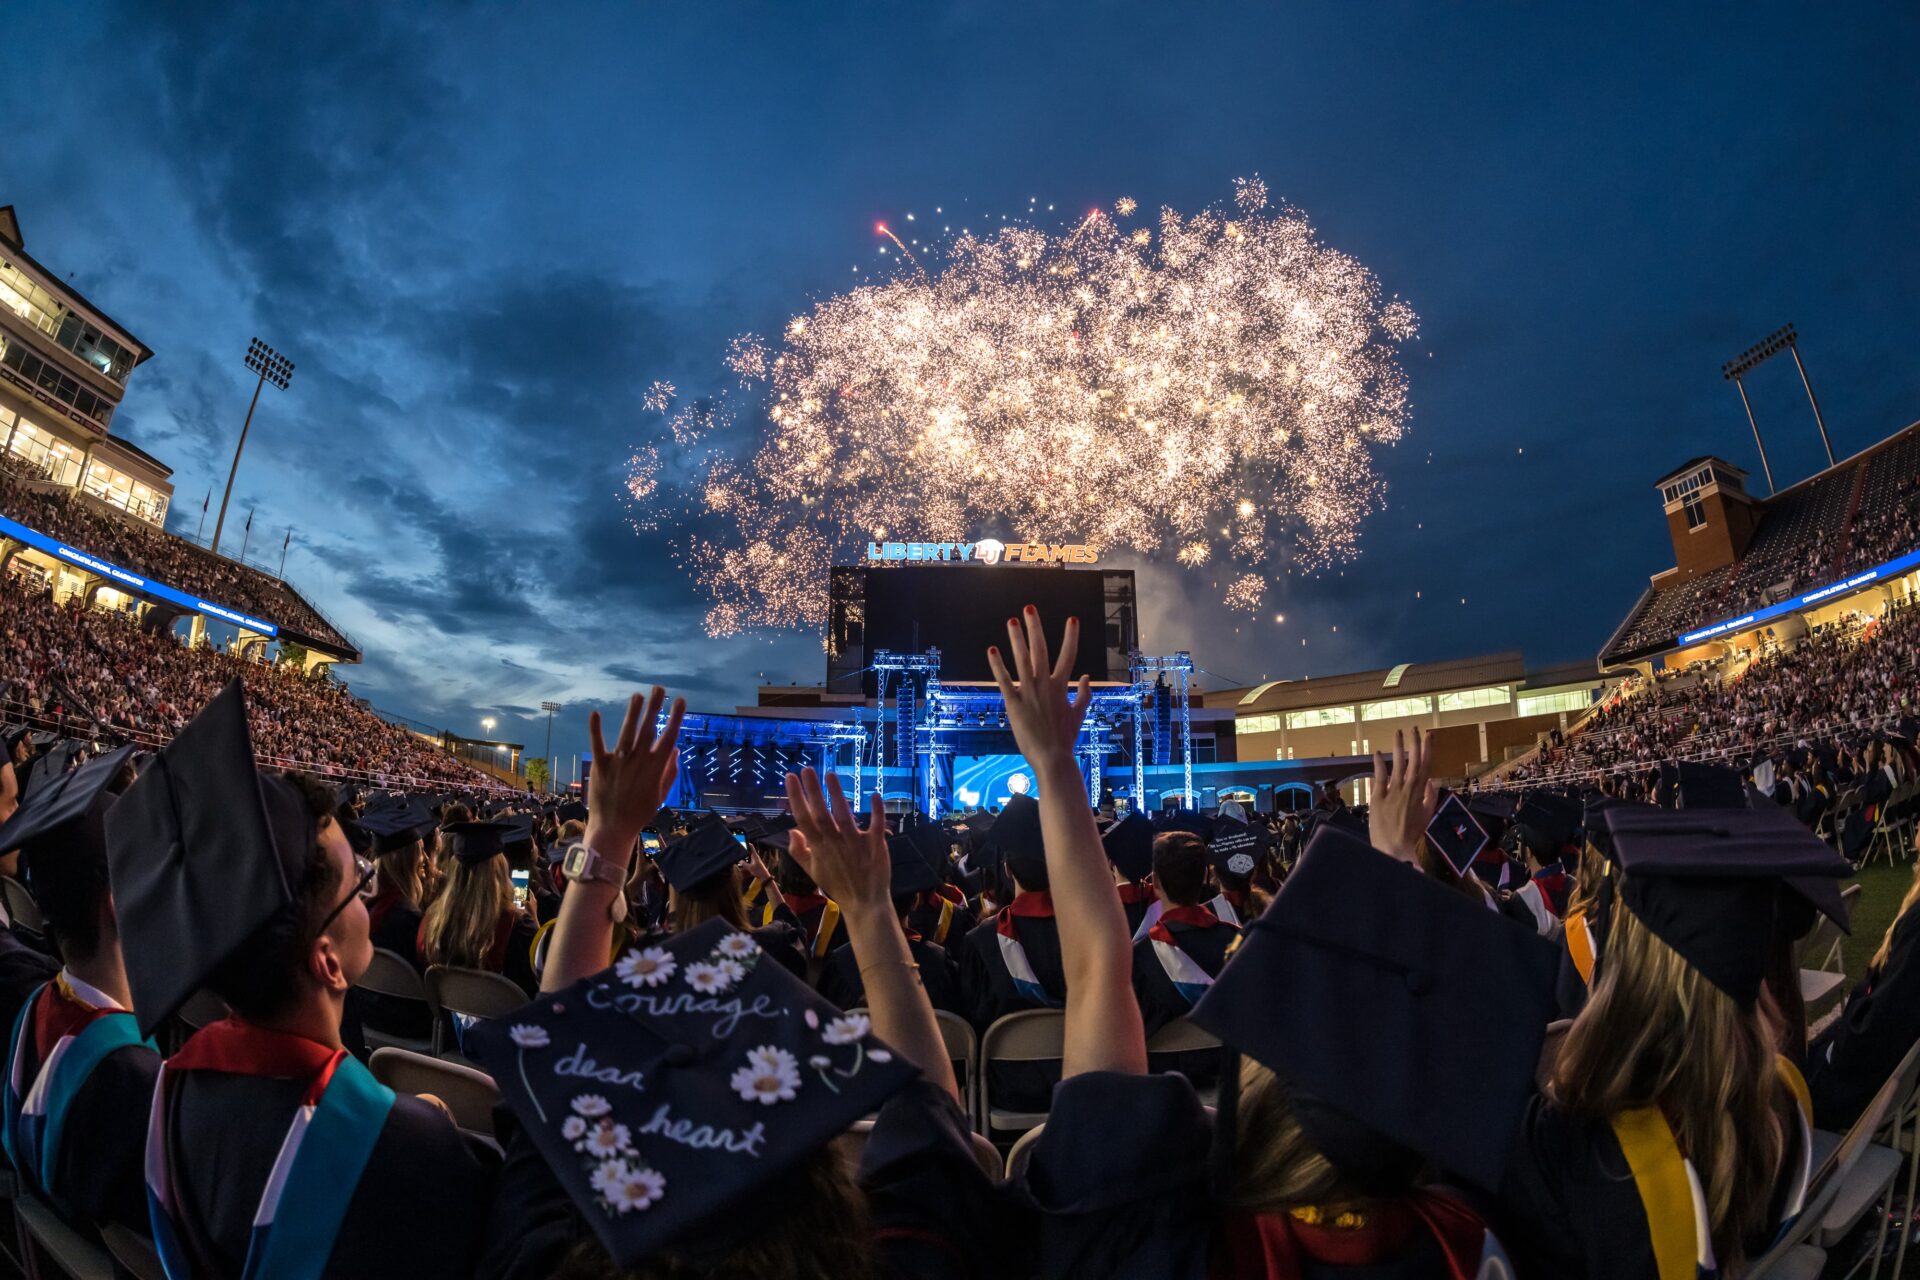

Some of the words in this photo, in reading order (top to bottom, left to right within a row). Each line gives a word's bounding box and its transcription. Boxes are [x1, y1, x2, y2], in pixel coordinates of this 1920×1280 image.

[867, 542, 976, 562] LIBERTY
[1003, 543, 1099, 564] FLAMES
[554, 1042, 645, 1091] dear
[639, 1103, 765, 1158] heart
